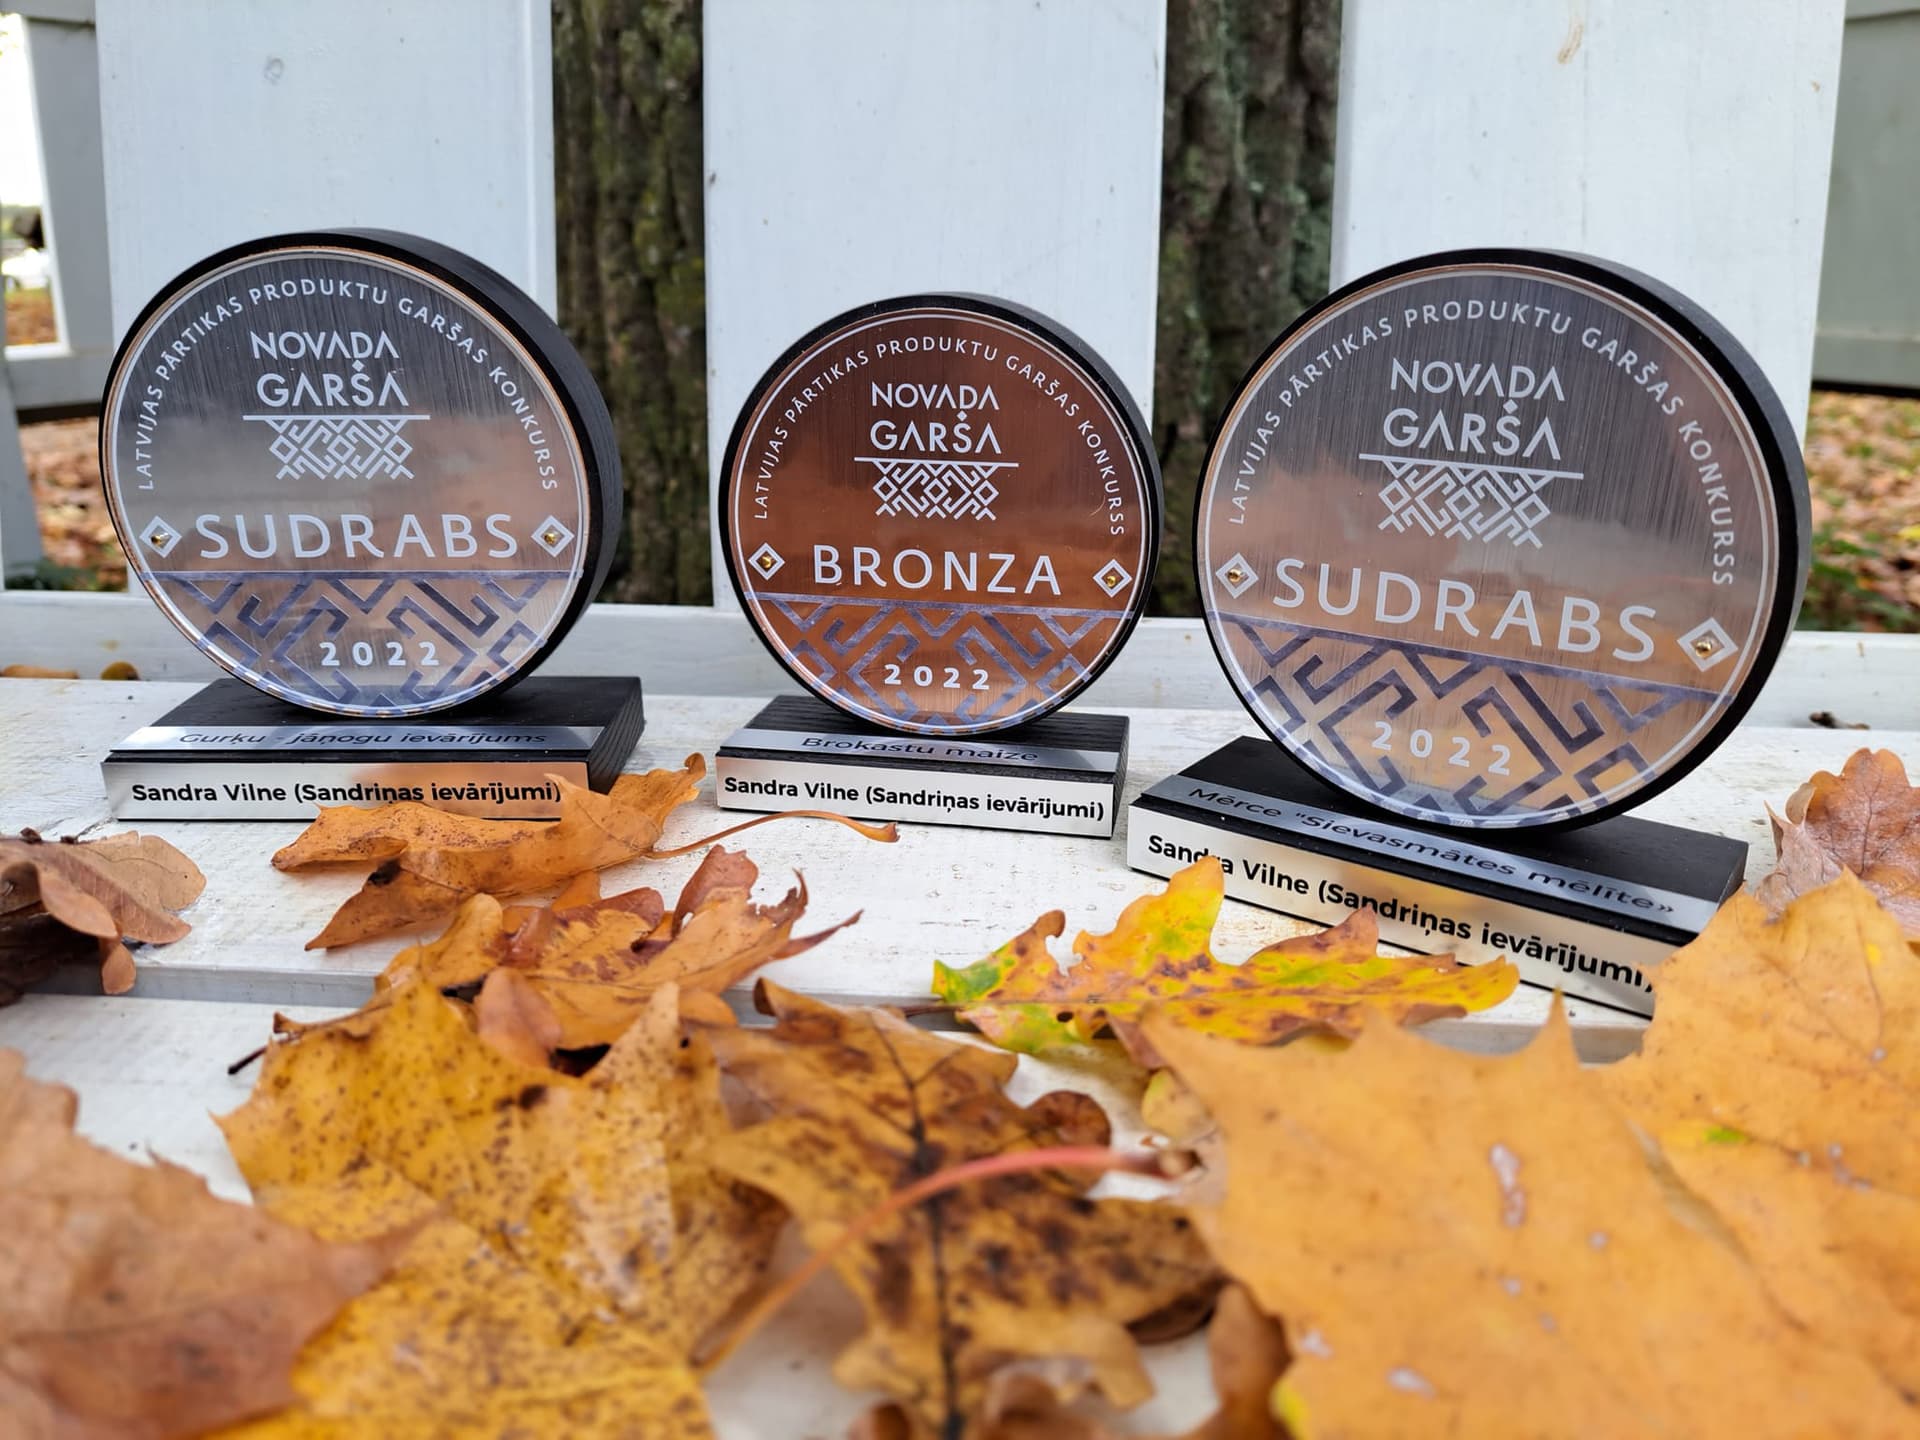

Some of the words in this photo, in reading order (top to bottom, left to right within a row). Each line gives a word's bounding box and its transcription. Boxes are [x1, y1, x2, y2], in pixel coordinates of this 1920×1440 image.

[251, 330, 399, 359] NOVADA
[135, 385, 163, 490] LATVIJAS
[156, 297, 243, 381] PĀRTIKAS
[250, 279, 388, 305] PRODUKTU
[399, 297, 489, 364] GARŠAS
[488, 366, 558, 490] KONKURSS
[871, 381, 1000, 411] NOVADA
[1390, 357, 1565, 401] NOVADA
[754, 427, 788, 520] LATVIJAS
[785, 350, 869, 423] PĀRTIKAS
[876, 336, 998, 361] PRODUKTU
[1006, 355, 1080, 417] GARŠAS
[1078, 420, 1125, 536] KONKURSS
[1229, 410, 1281, 526] LATVIJAS
[1278, 316, 1393, 409] PĀRTIKAS
[1404, 299, 1572, 335] PRODUKTU
[1582, 327, 1684, 416] GARŠAS
[1678, 419, 1734, 586] KONKURSS
[196, 513, 518, 560] SUDRABS
[813, 545, 1061, 596] BRONZA
[1272, 557, 1657, 663] SUDRABS
[318, 640, 440, 667] 2022
[884, 664, 990, 691] 2022
[400, 732, 548, 745] ievārījums
[802, 737, 935, 755] Brokastu
[945, 749, 1039, 762] maize
[1371, 720, 1511, 776] 2022
[132, 784, 217, 801] Sandra
[223, 784, 286, 801] Vilne
[294, 783, 424, 804] (Sandriņas
[431, 782, 561, 804] ievārījumi)
[724, 777, 799, 798] Sandra
[804, 782, 860, 802] Vilne
[865, 786, 980, 813] (Sandriņas
[987, 794, 1104, 821] ievārījumi)
[1188, 788, 1282, 817] Mērce
[1148, 835, 1234, 875] Sanda
[1243, 859, 1309, 894] Vilne
[1318, 880, 1471, 940] (Sandriņas
[1481, 922, 1653, 993] ievārījumi
